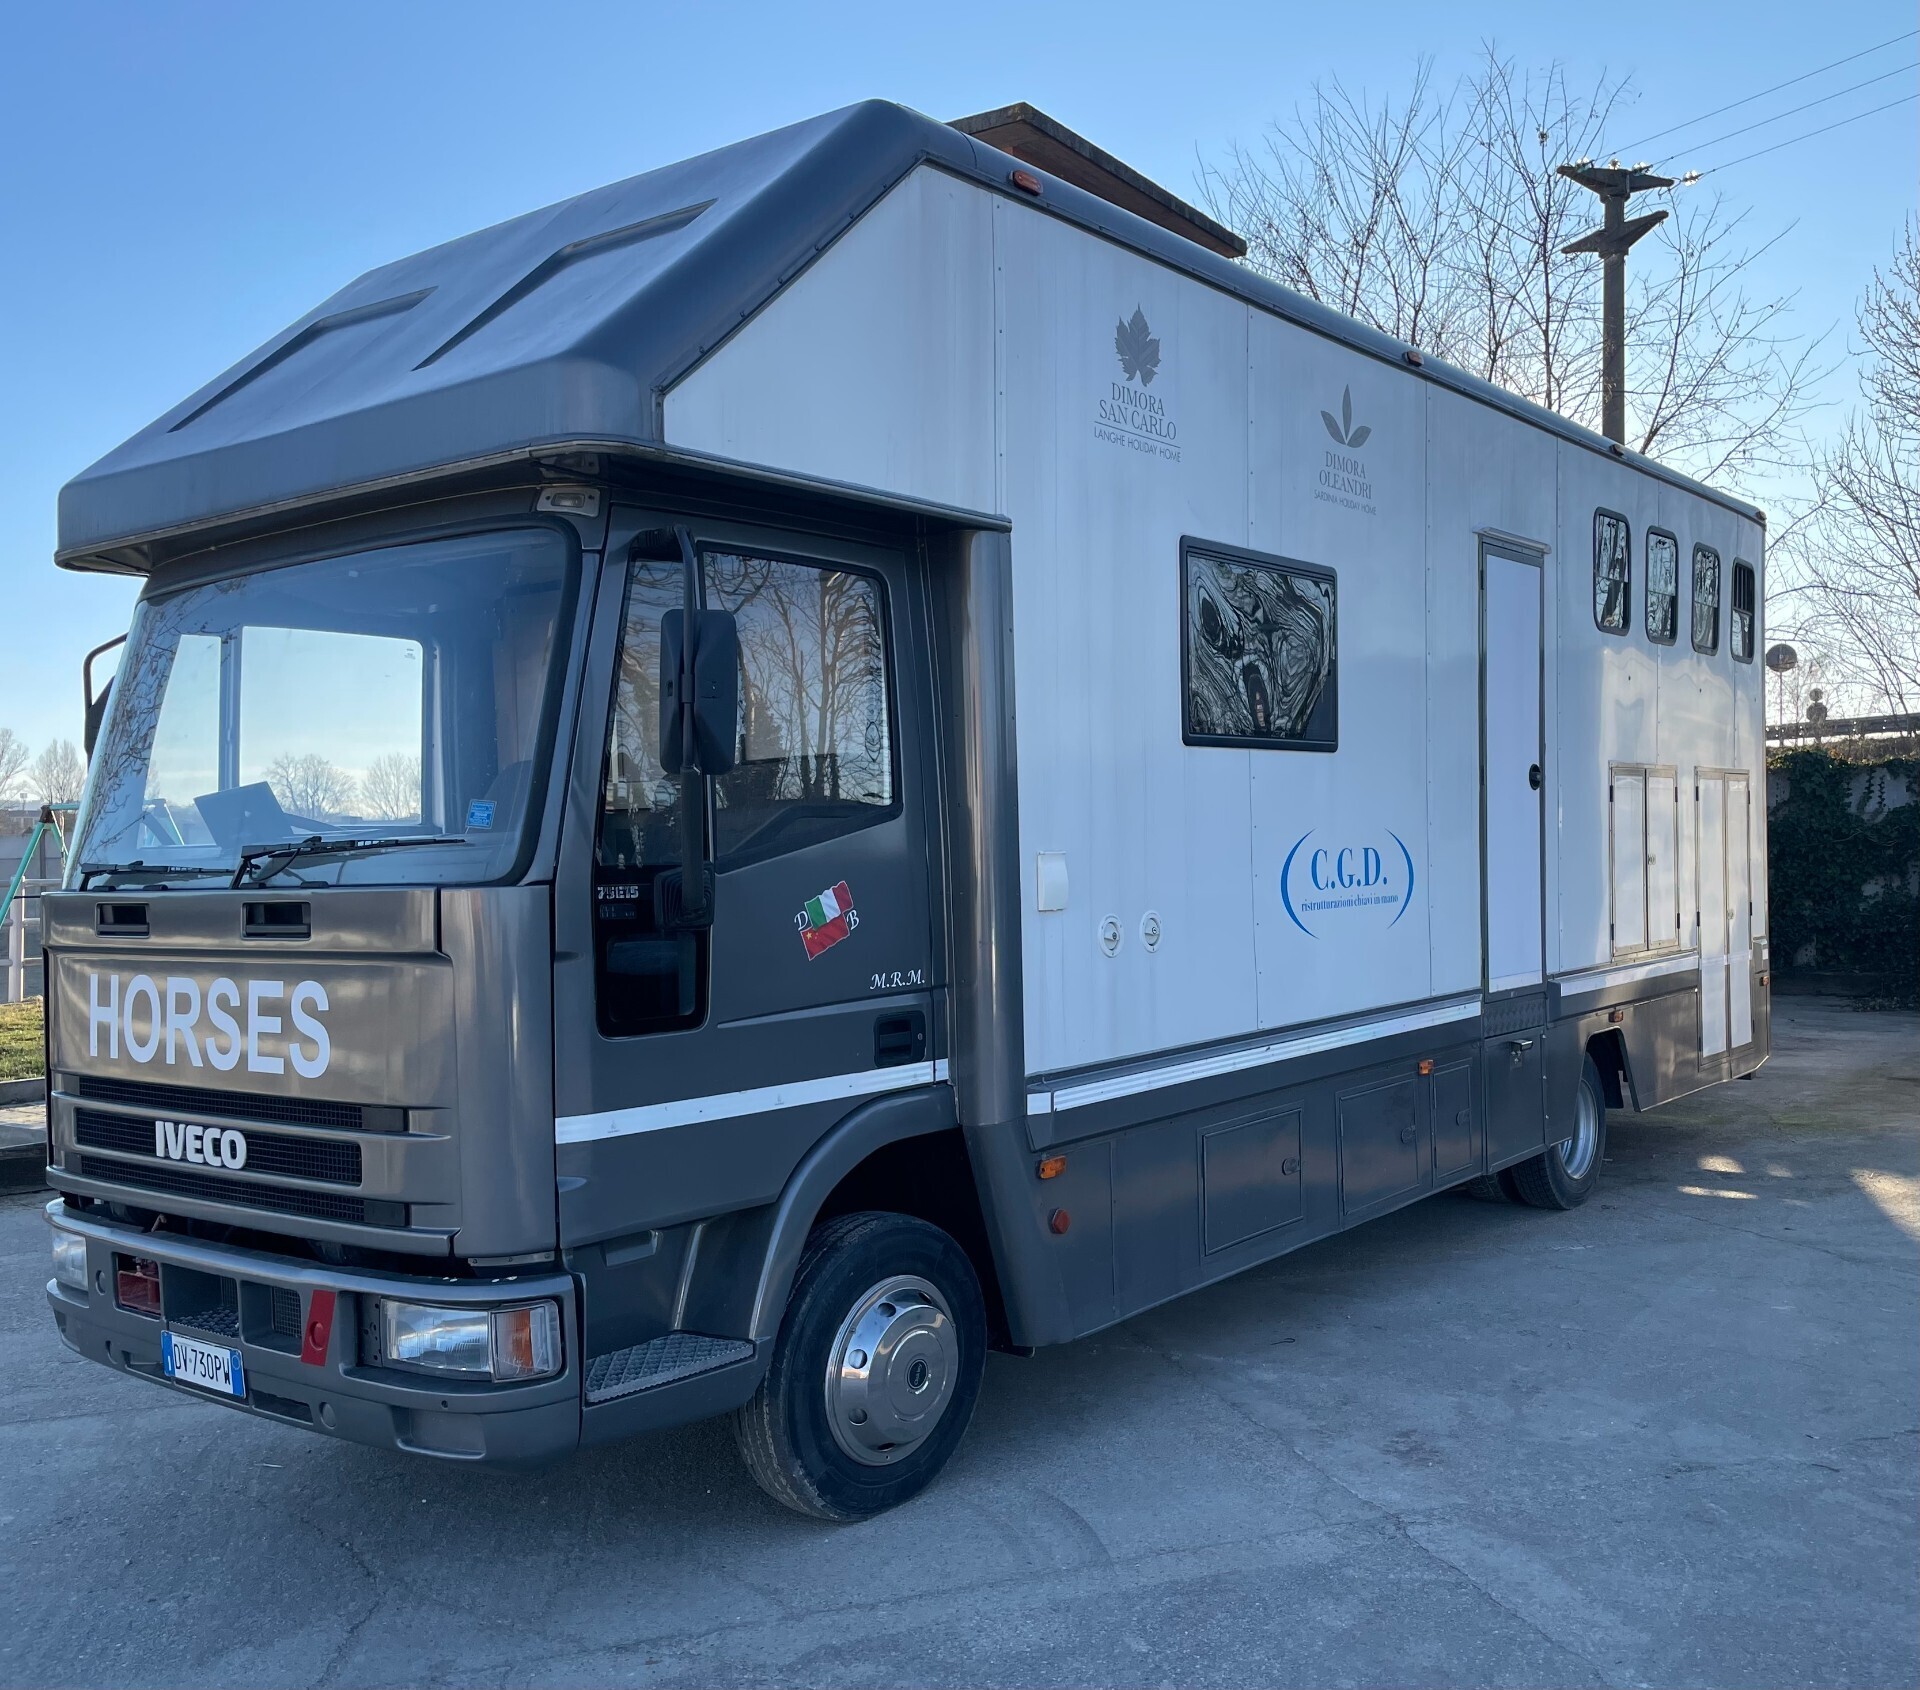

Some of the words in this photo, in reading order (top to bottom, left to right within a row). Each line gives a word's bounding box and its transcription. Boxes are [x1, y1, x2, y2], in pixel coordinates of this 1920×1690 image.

[1112, 382, 1165, 416] DIMORA
[1099, 399, 1128, 425] SAN
[1132, 410, 1176, 440] CARLO
[1094, 426, 1126, 447] LANGHE
[1127, 437, 1158, 455] HOLIDAY
[1159, 447, 1181, 462] HOME
[1325, 450, 1366, 479] DIMORA
[1319, 469, 1372, 500] OLEANDRI
[1310, 847, 1388, 891] C.G.D.
[1301, 895, 1354, 912] ristrutturazioni
[1354, 893, 1373, 907] chiavi
[1381, 894, 1399, 904] mano
[794, 910, 808, 931] D
[846, 909, 860, 931] B
[869, 969, 926, 990] M.R.M.
[89, 973, 331, 1079] HORSES
[155, 1120, 248, 1170] IVECO
